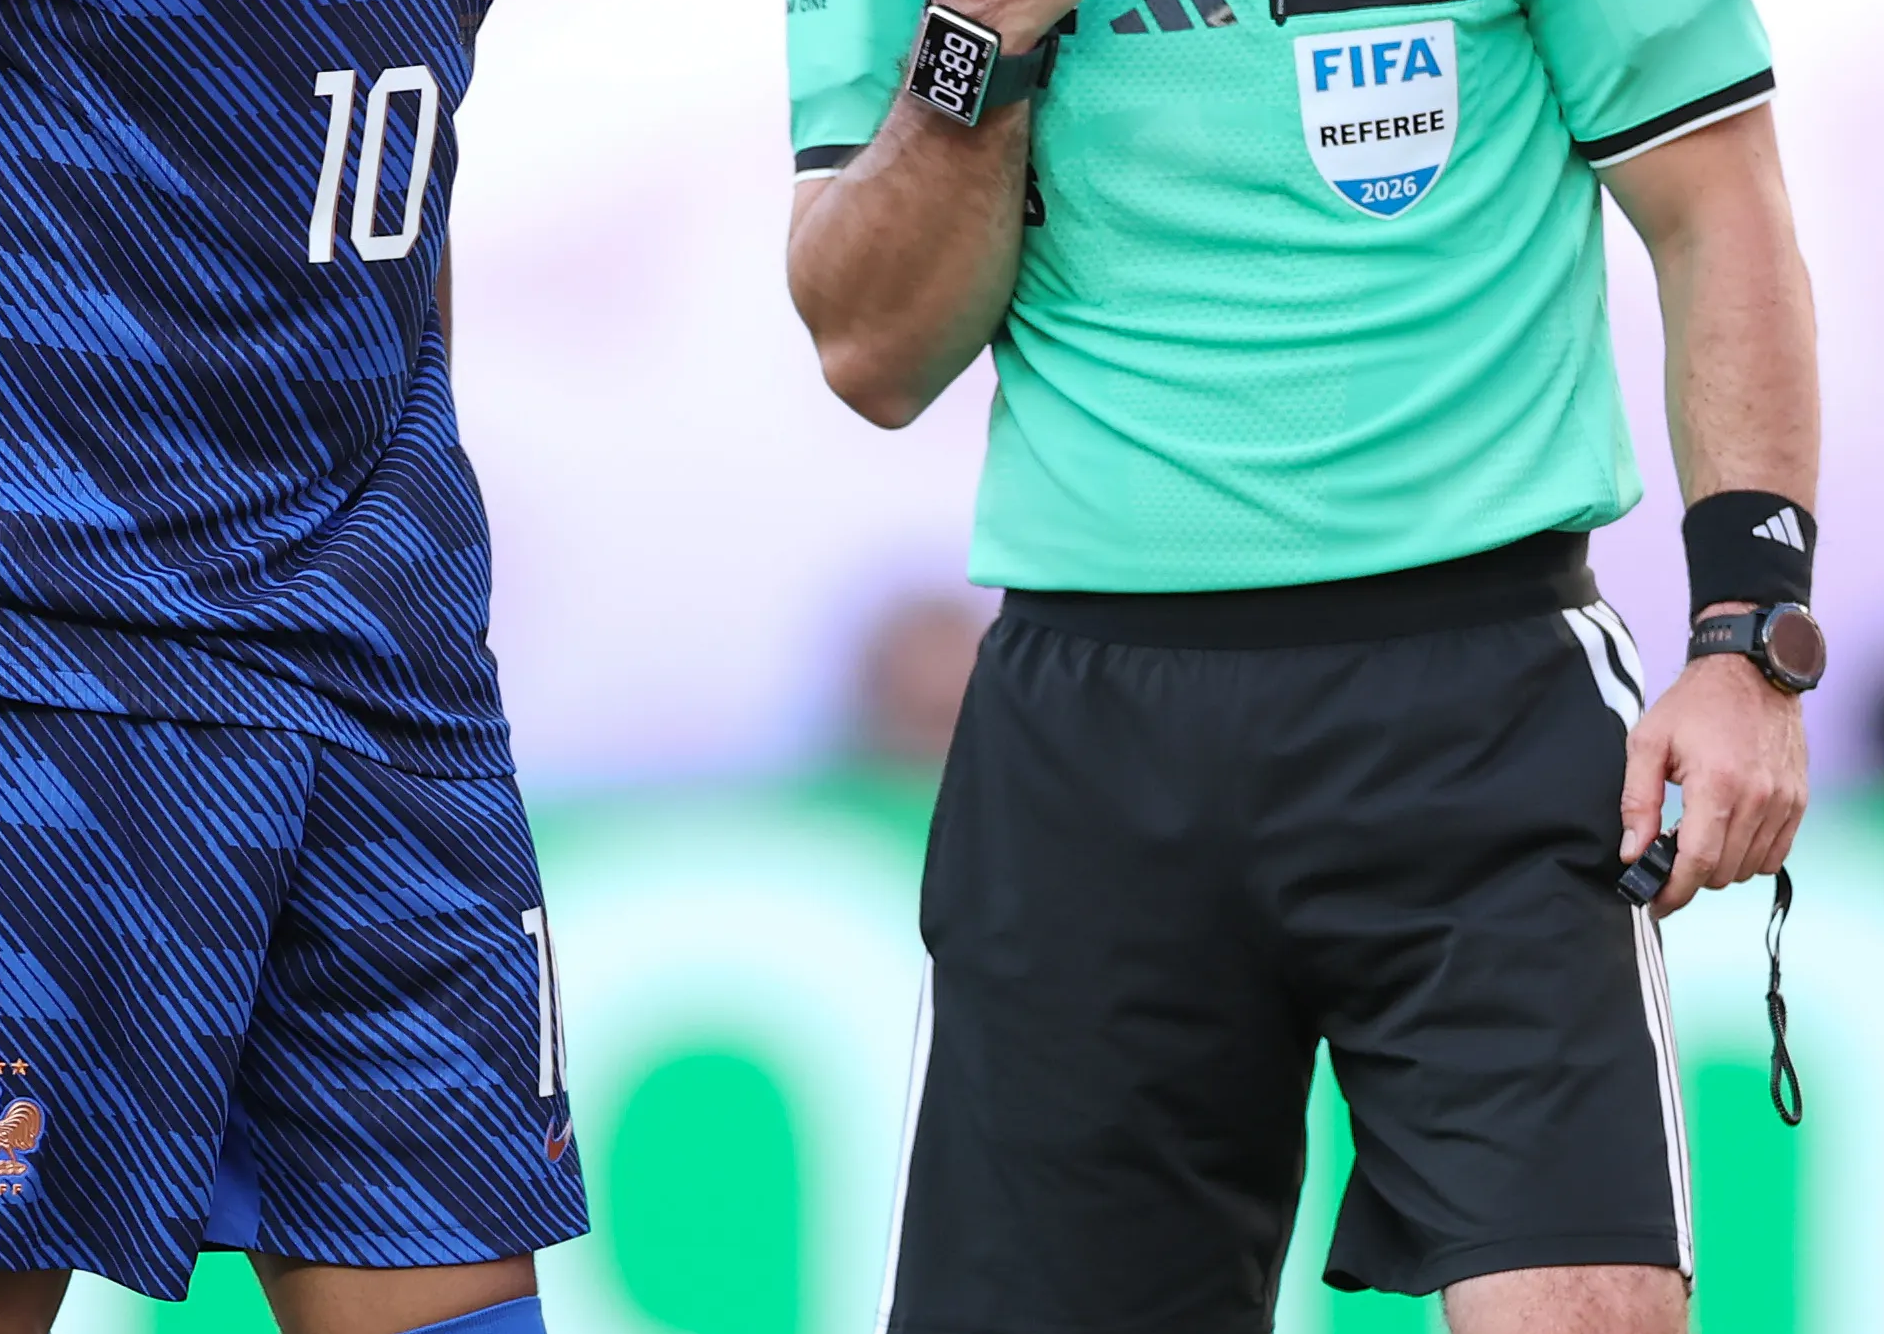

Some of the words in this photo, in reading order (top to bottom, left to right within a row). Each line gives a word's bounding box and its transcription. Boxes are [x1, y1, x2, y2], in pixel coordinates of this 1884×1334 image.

[929, 31, 979, 112] 68:30
[1312, 36, 1443, 93] FIFA
[1319, 109, 1445, 148] REFEREE
[309, 64, 440, 264] 10
[1360, 175, 1417, 204] 2026
[521, 905, 568, 1099] 1
